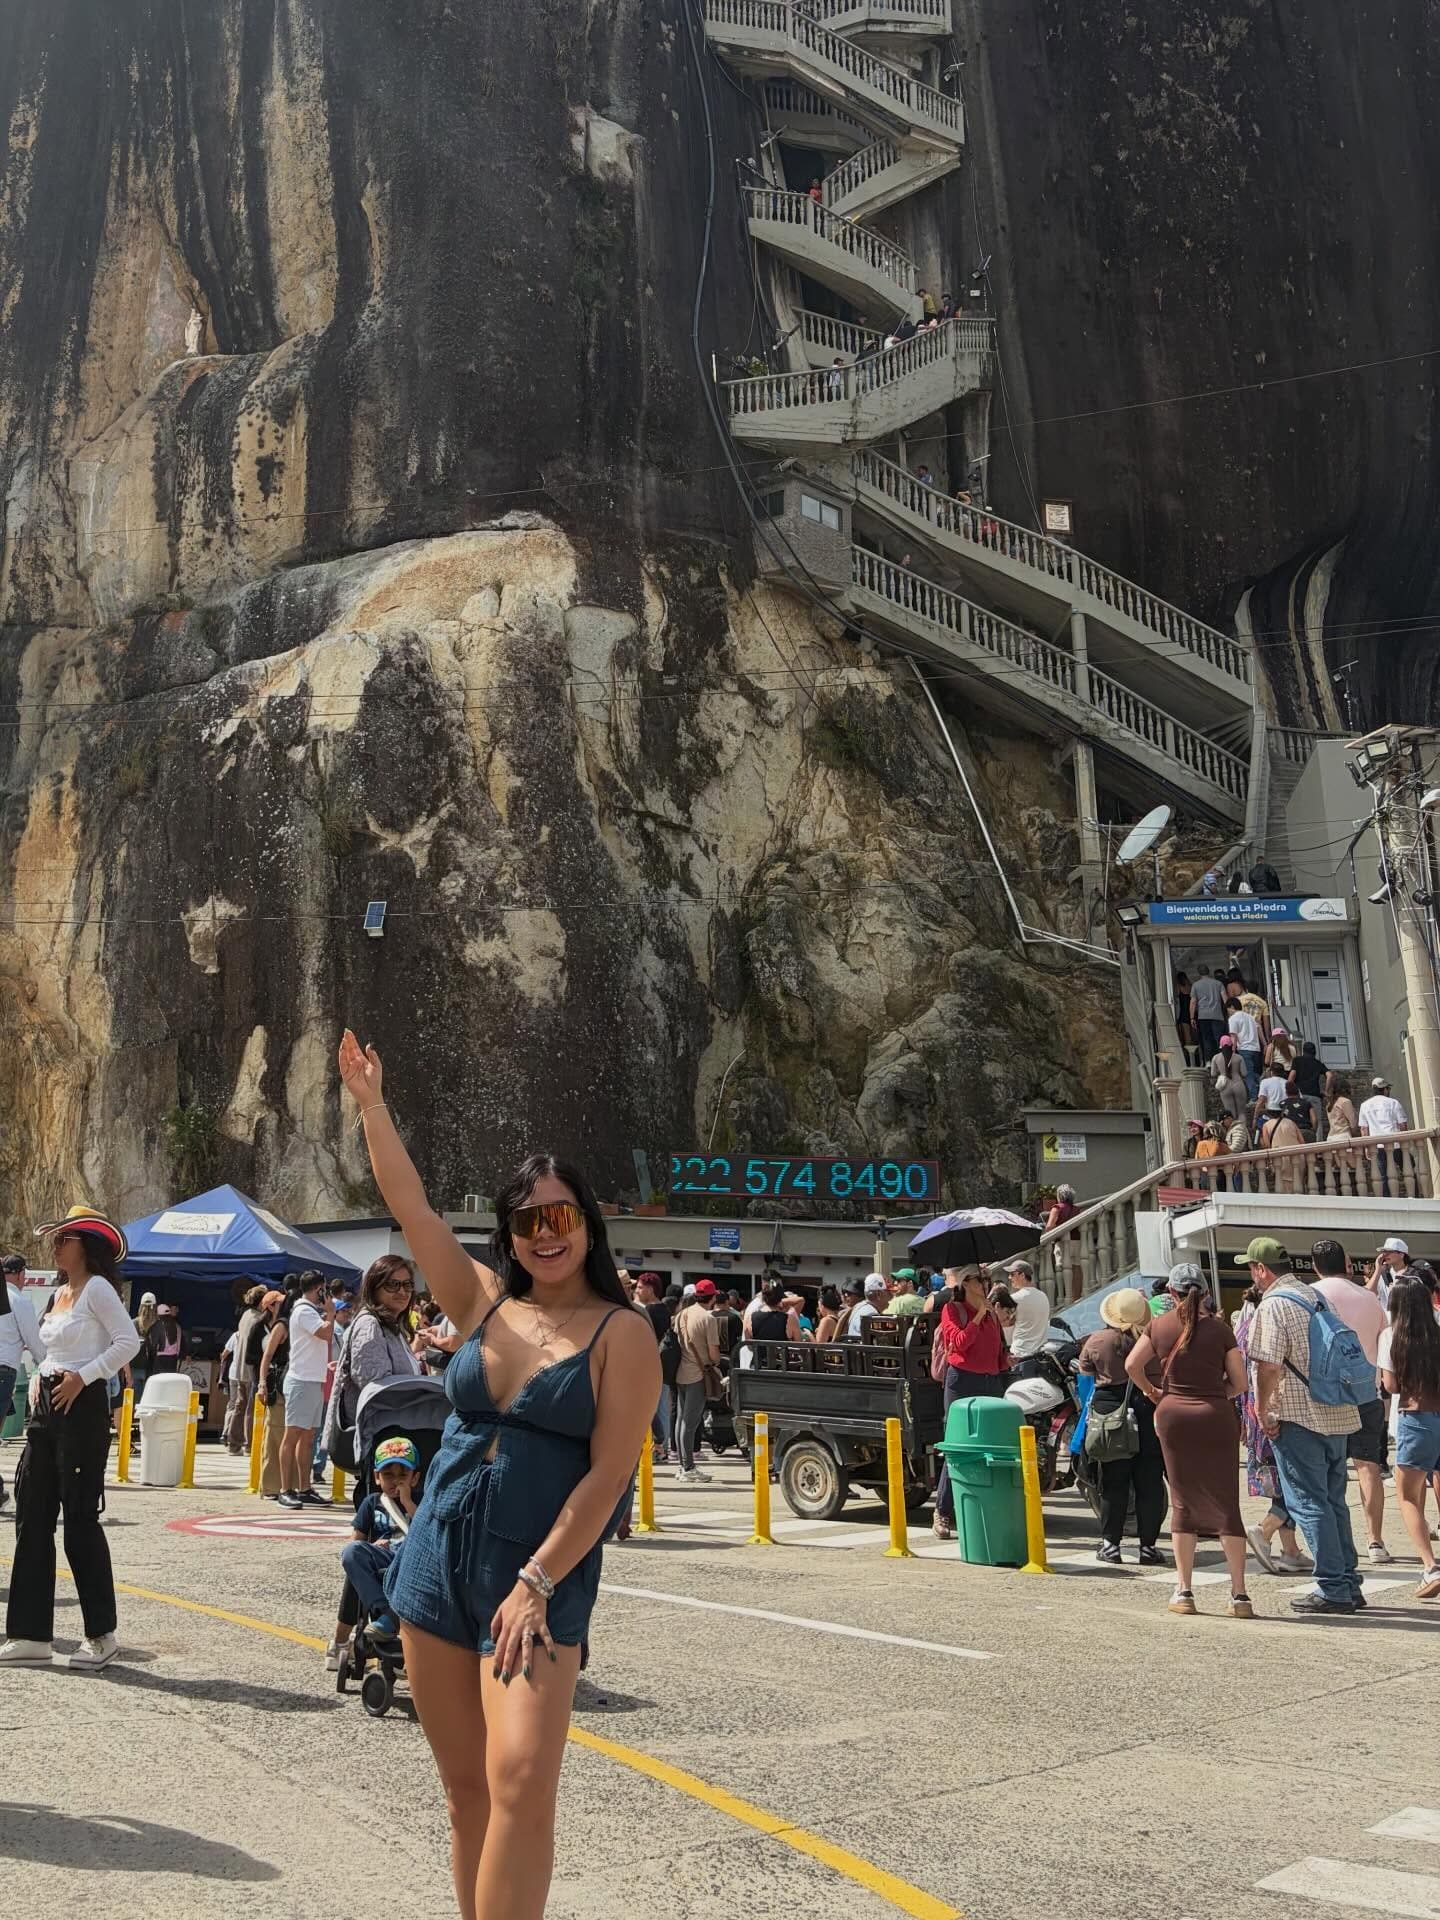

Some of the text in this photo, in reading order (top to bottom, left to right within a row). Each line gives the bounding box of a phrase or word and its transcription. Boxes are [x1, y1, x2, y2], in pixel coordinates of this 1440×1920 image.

[1166, 904, 1228, 914] Bienvenidos
[1239, 904, 1251, 912] La
[1253, 903, 1287, 912] Piedra
[1242, 912, 1268, 920] Piedra
[745, 1160, 816, 1195] 574
[830, 1161, 929, 1199] 8490
